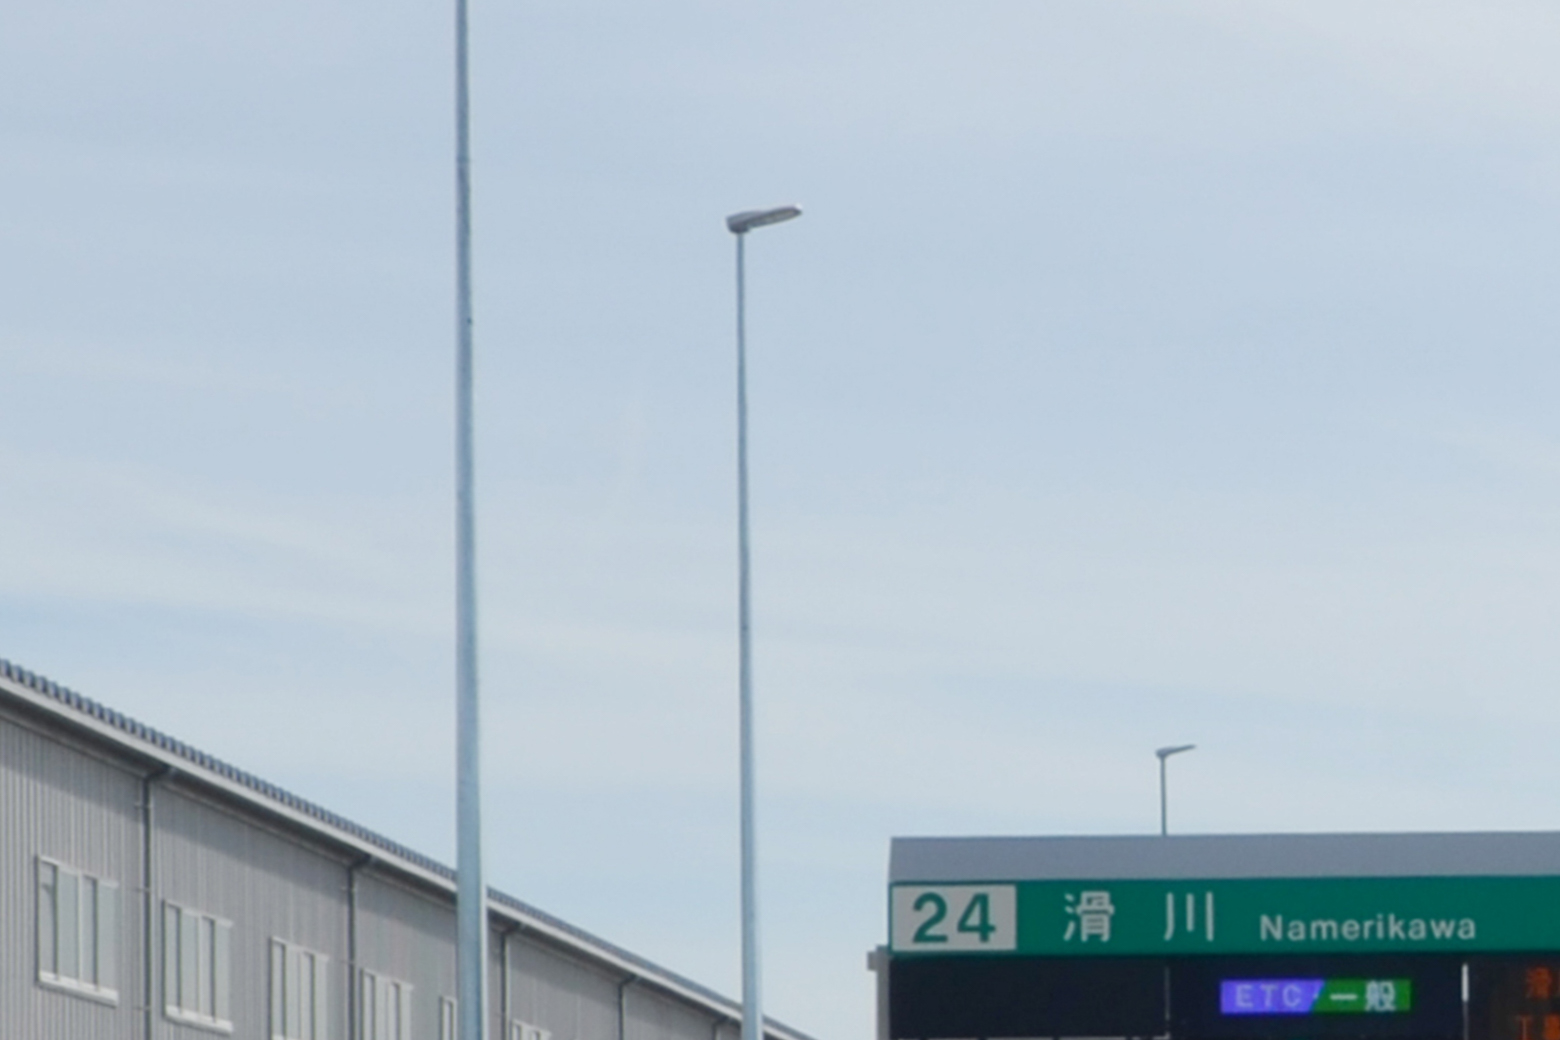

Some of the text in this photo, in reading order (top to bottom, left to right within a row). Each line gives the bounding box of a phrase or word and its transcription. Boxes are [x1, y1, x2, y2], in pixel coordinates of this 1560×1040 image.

[912, 892, 997, 943] 24
[1063, 891, 1215, 942] 滑川
[1259, 913, 1477, 942] Namerikawa
[1235, 984, 1301, 1008] ETC
